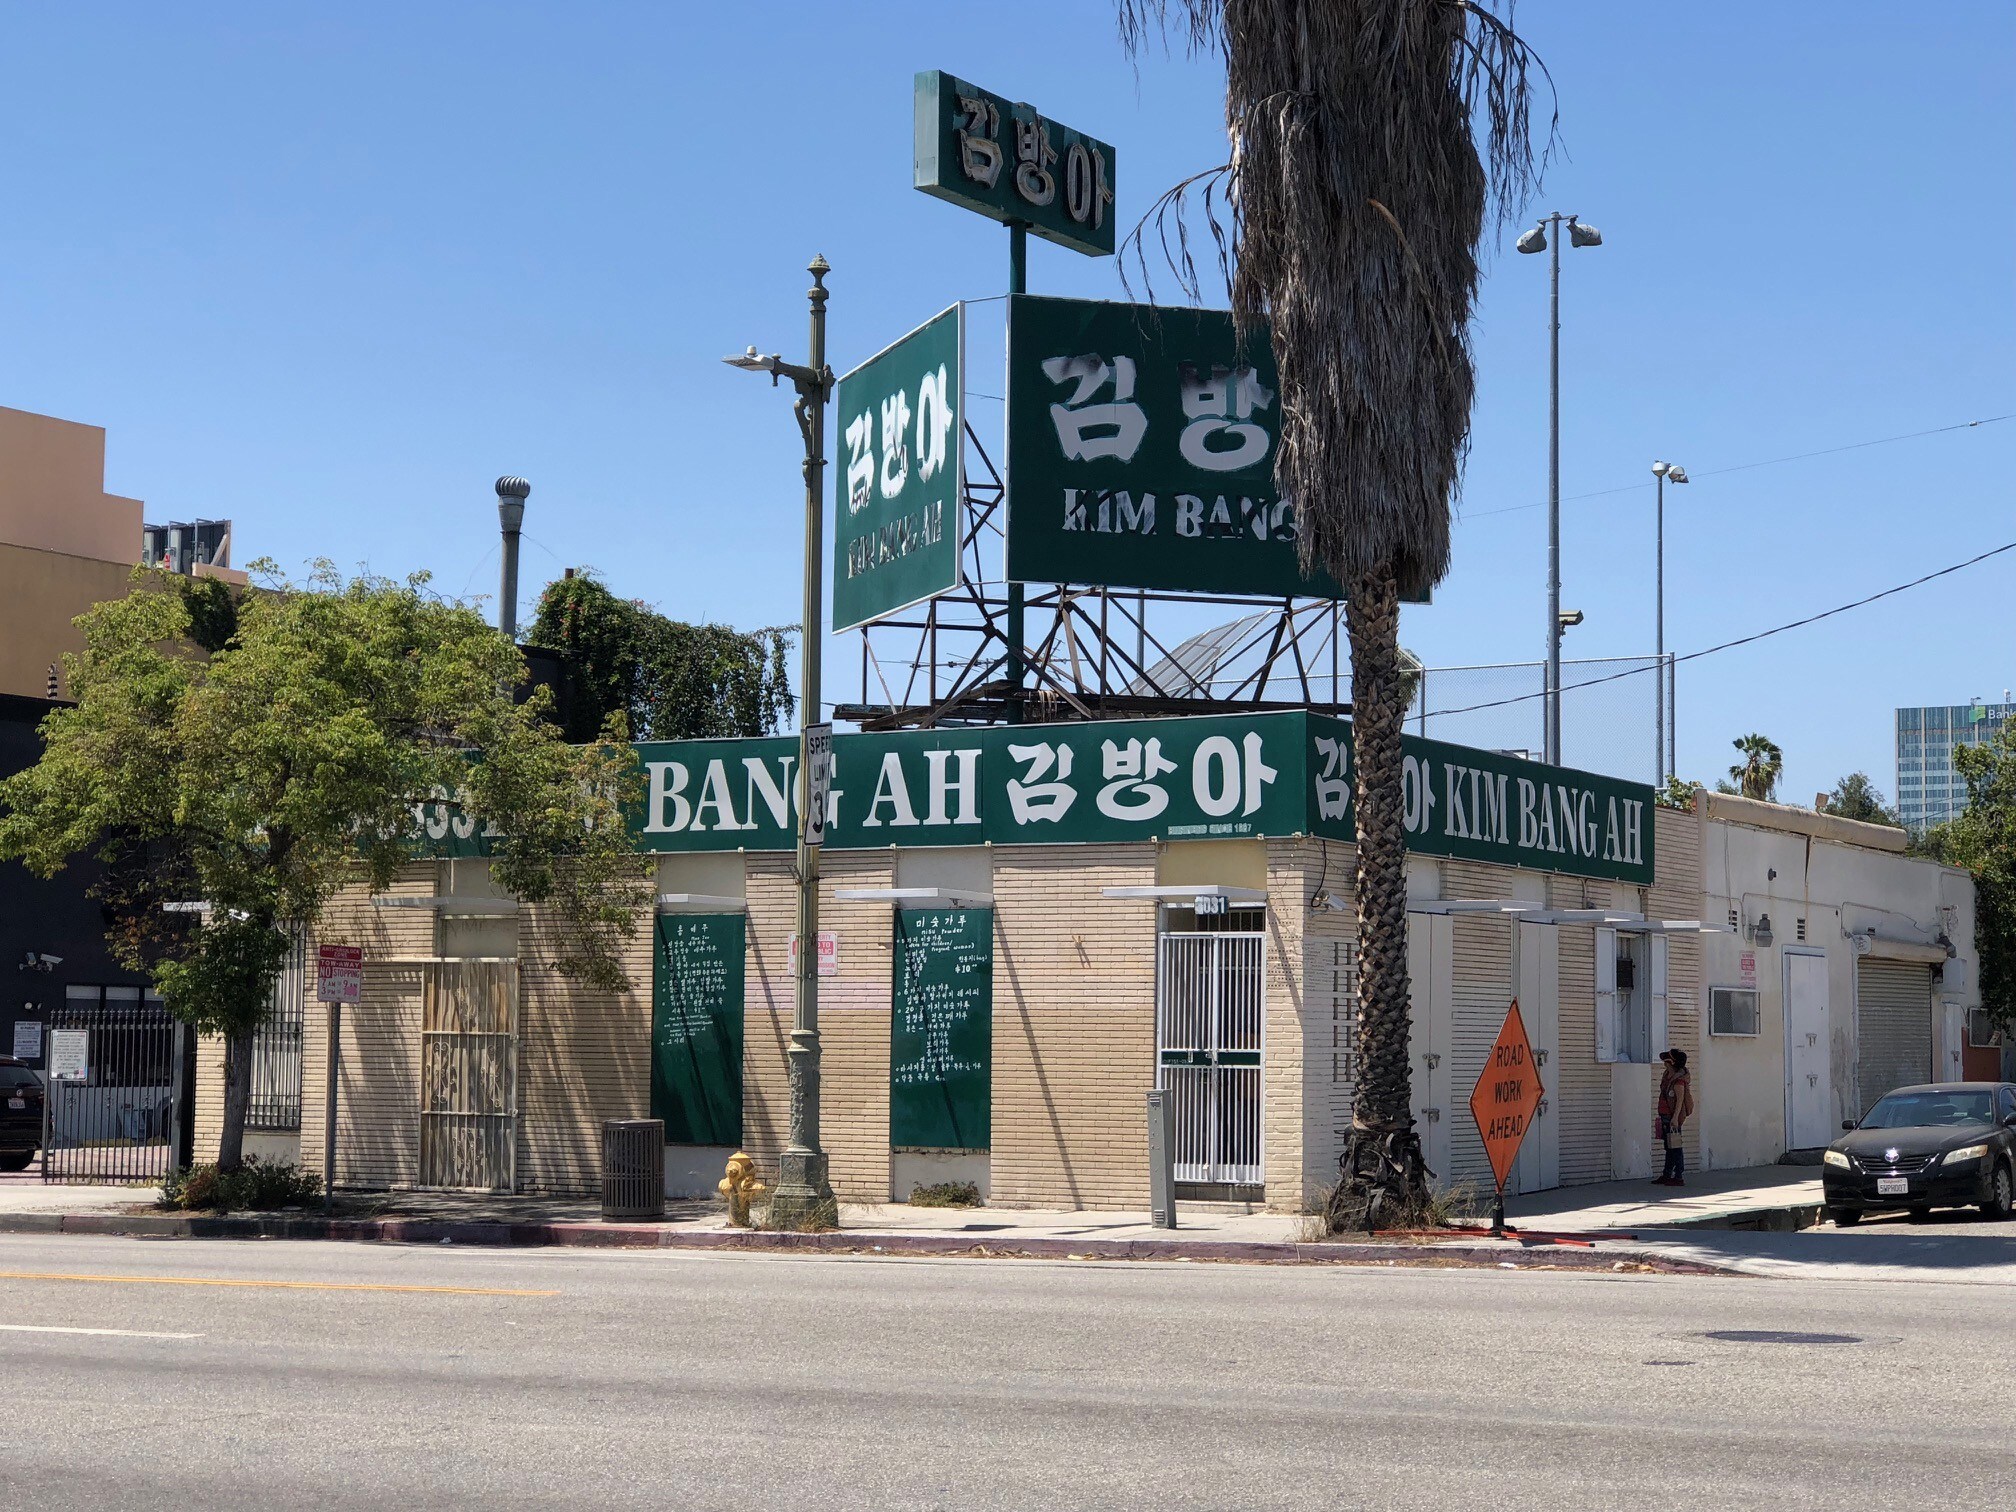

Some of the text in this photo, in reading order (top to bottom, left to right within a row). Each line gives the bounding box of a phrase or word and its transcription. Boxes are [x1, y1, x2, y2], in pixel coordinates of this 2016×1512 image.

[953, 91, 1115, 231] 김방아
[1040, 353, 1274, 472] 김방
[845, 362, 954, 518] 김방아
[1062, 487, 1158, 536] KIM
[809, 735, 831, 755] SPEE
[862, 748, 983, 828] AH
[1005, 731, 1278, 826] 김방아
[1314, 735, 1643, 866] 김아 KIM BANG AH
[916, 914, 967, 928] 미숫가루
[320, 967, 331, 978] NO
[1496, 1044, 1523, 1068] ROAD
[1494, 1080, 1522, 1104] WORK
[1487, 1114, 1523, 1142] AHEAD
